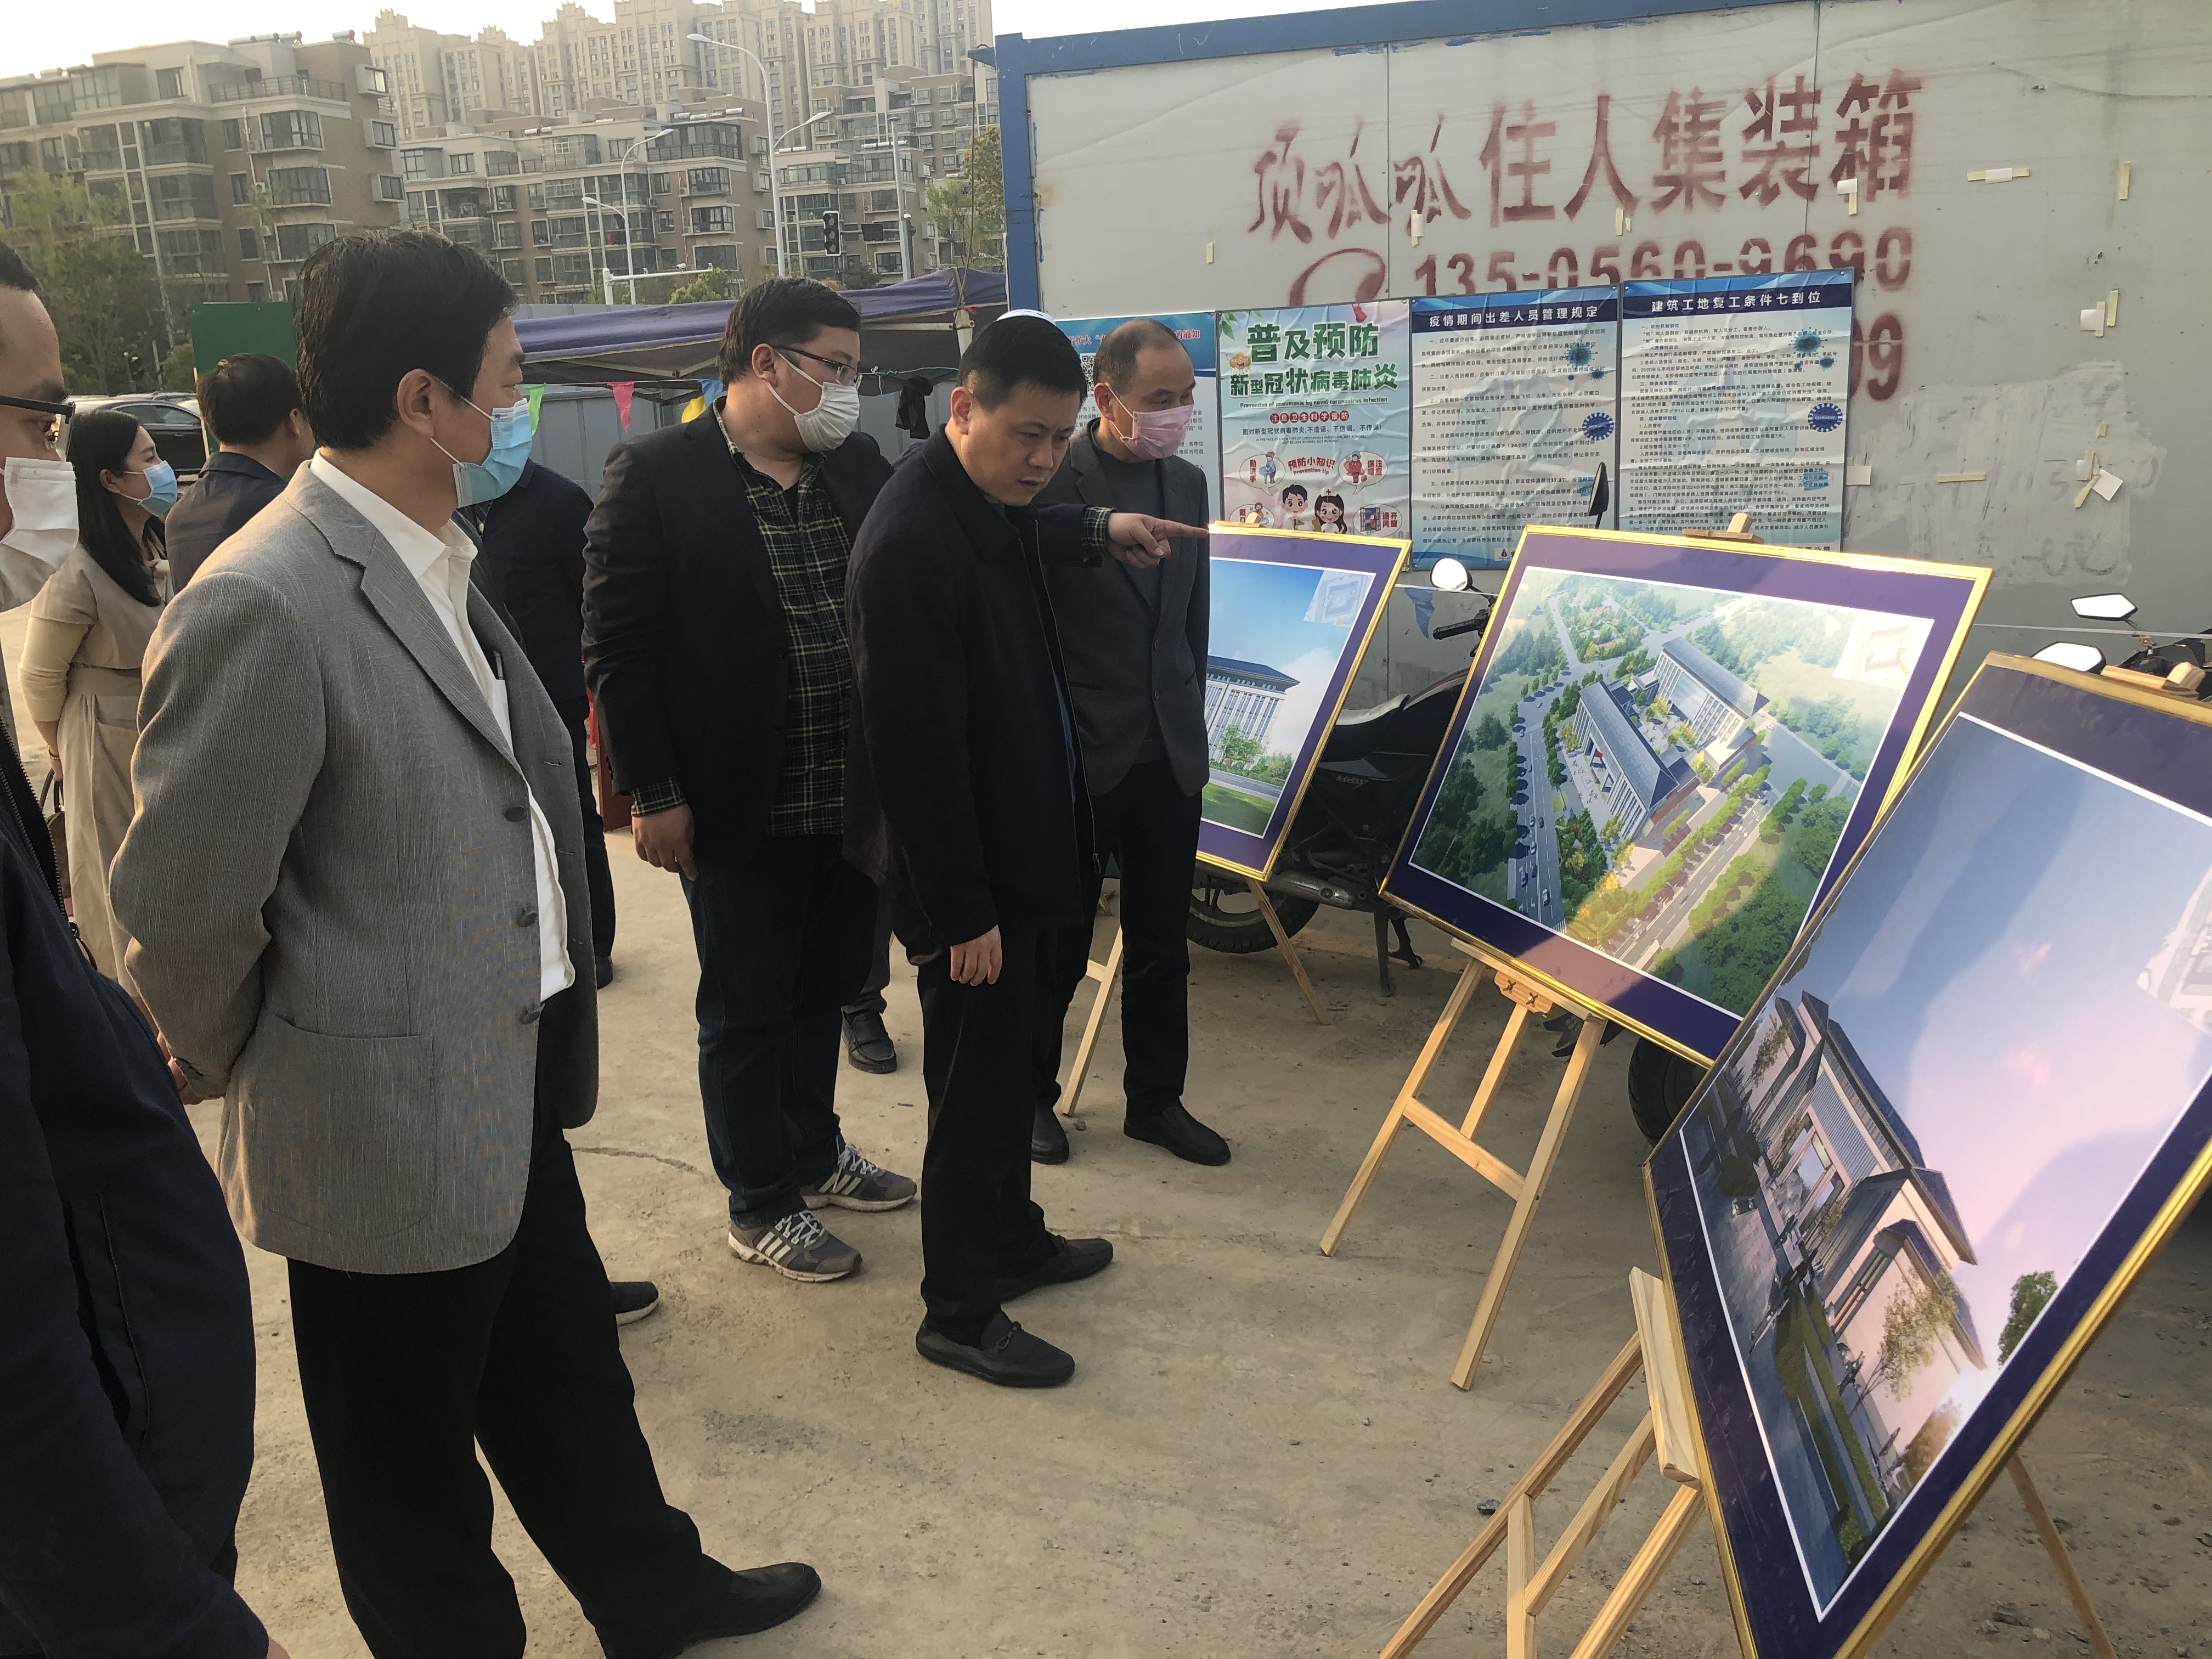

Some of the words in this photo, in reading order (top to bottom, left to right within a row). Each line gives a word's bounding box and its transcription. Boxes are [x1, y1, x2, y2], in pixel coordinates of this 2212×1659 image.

[1651, 290, 1822, 313] 建筑工地复工条件七到位
[1429, 305, 1599, 328] 疫情期间出差人员管理规定
[1247, 321, 1379, 363] 普及预防
[1230, 363, 1398, 396] 新型冠状病毒肺炎
[1271, 411, 1348, 423] 注意卫生科学预防
[1288, 456, 1335, 471] 预防小知识
